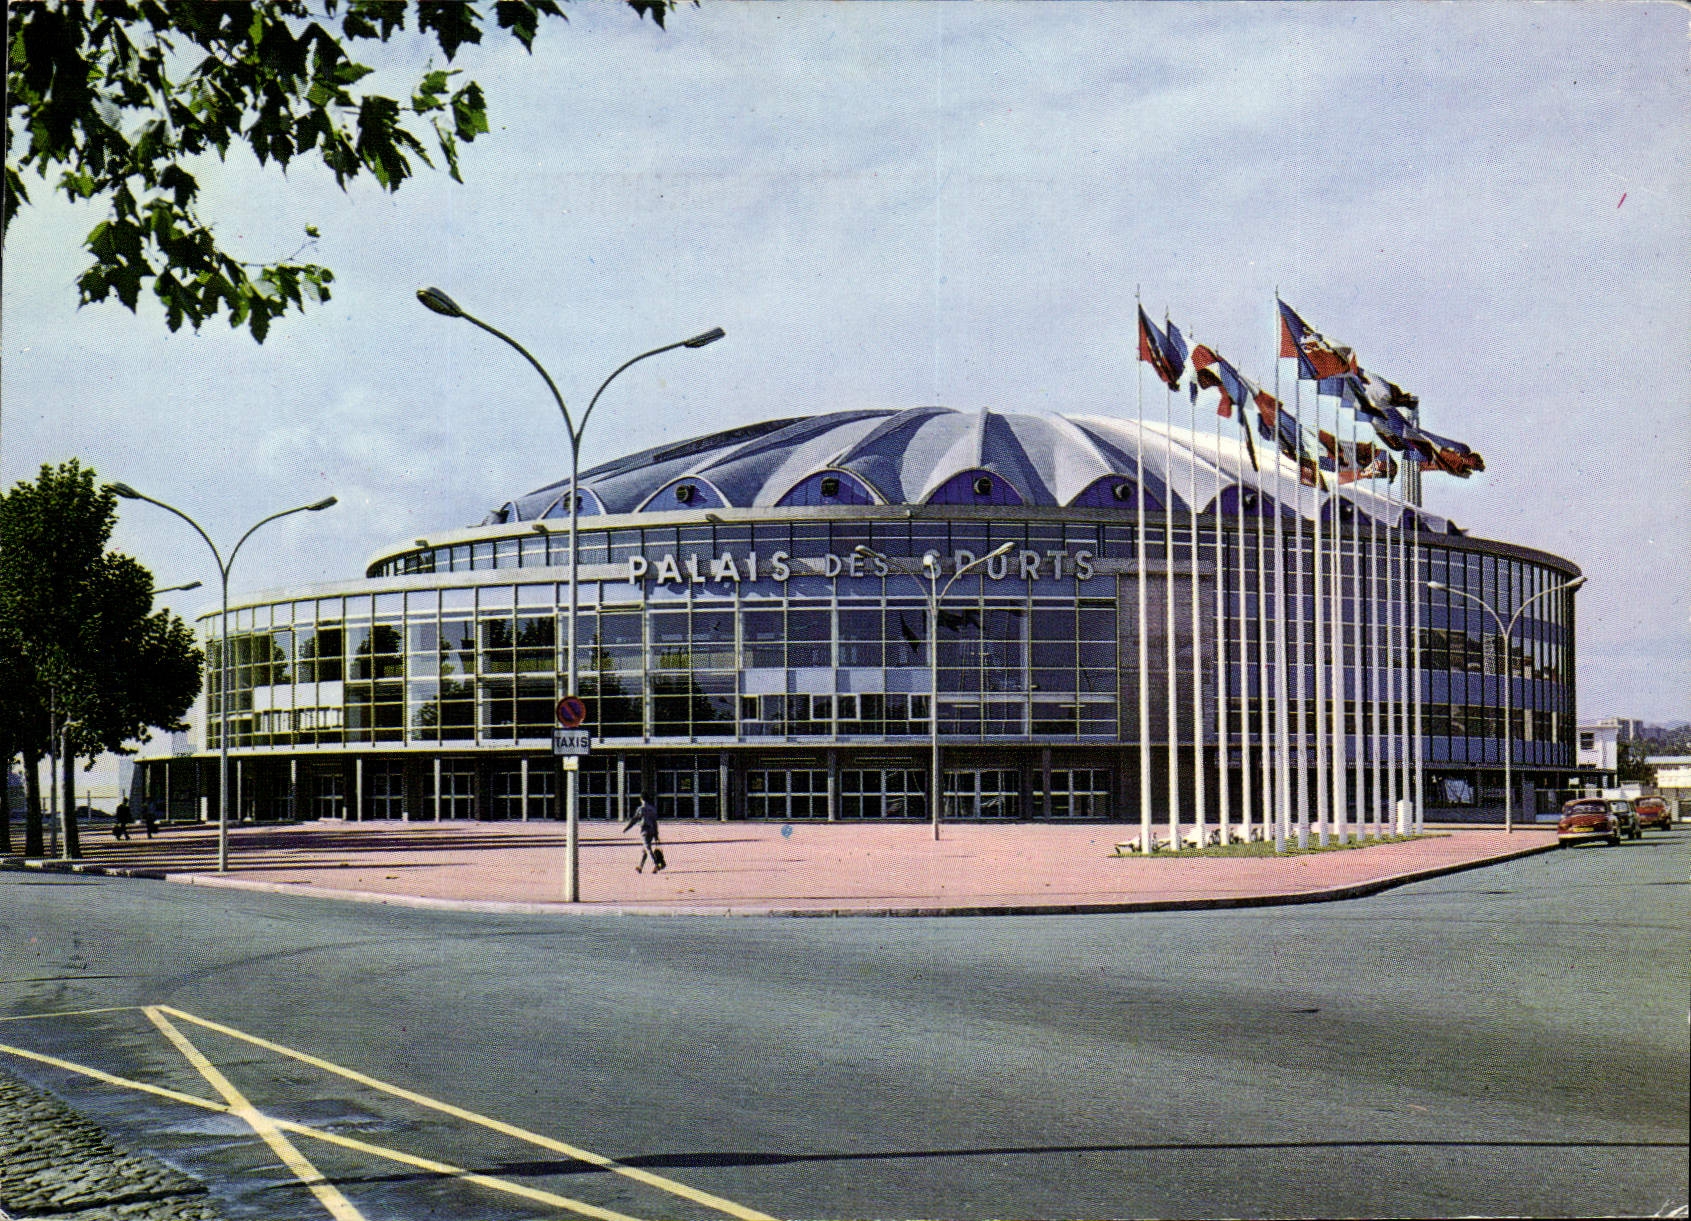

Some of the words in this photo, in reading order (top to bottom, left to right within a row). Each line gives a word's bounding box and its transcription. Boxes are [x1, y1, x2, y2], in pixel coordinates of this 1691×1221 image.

[628, 551, 791, 585] PALAIS
[825, 552, 889, 578] DES
[922, 549, 1095, 581] SPORTS
[555, 736, 588, 748] TAXIS
